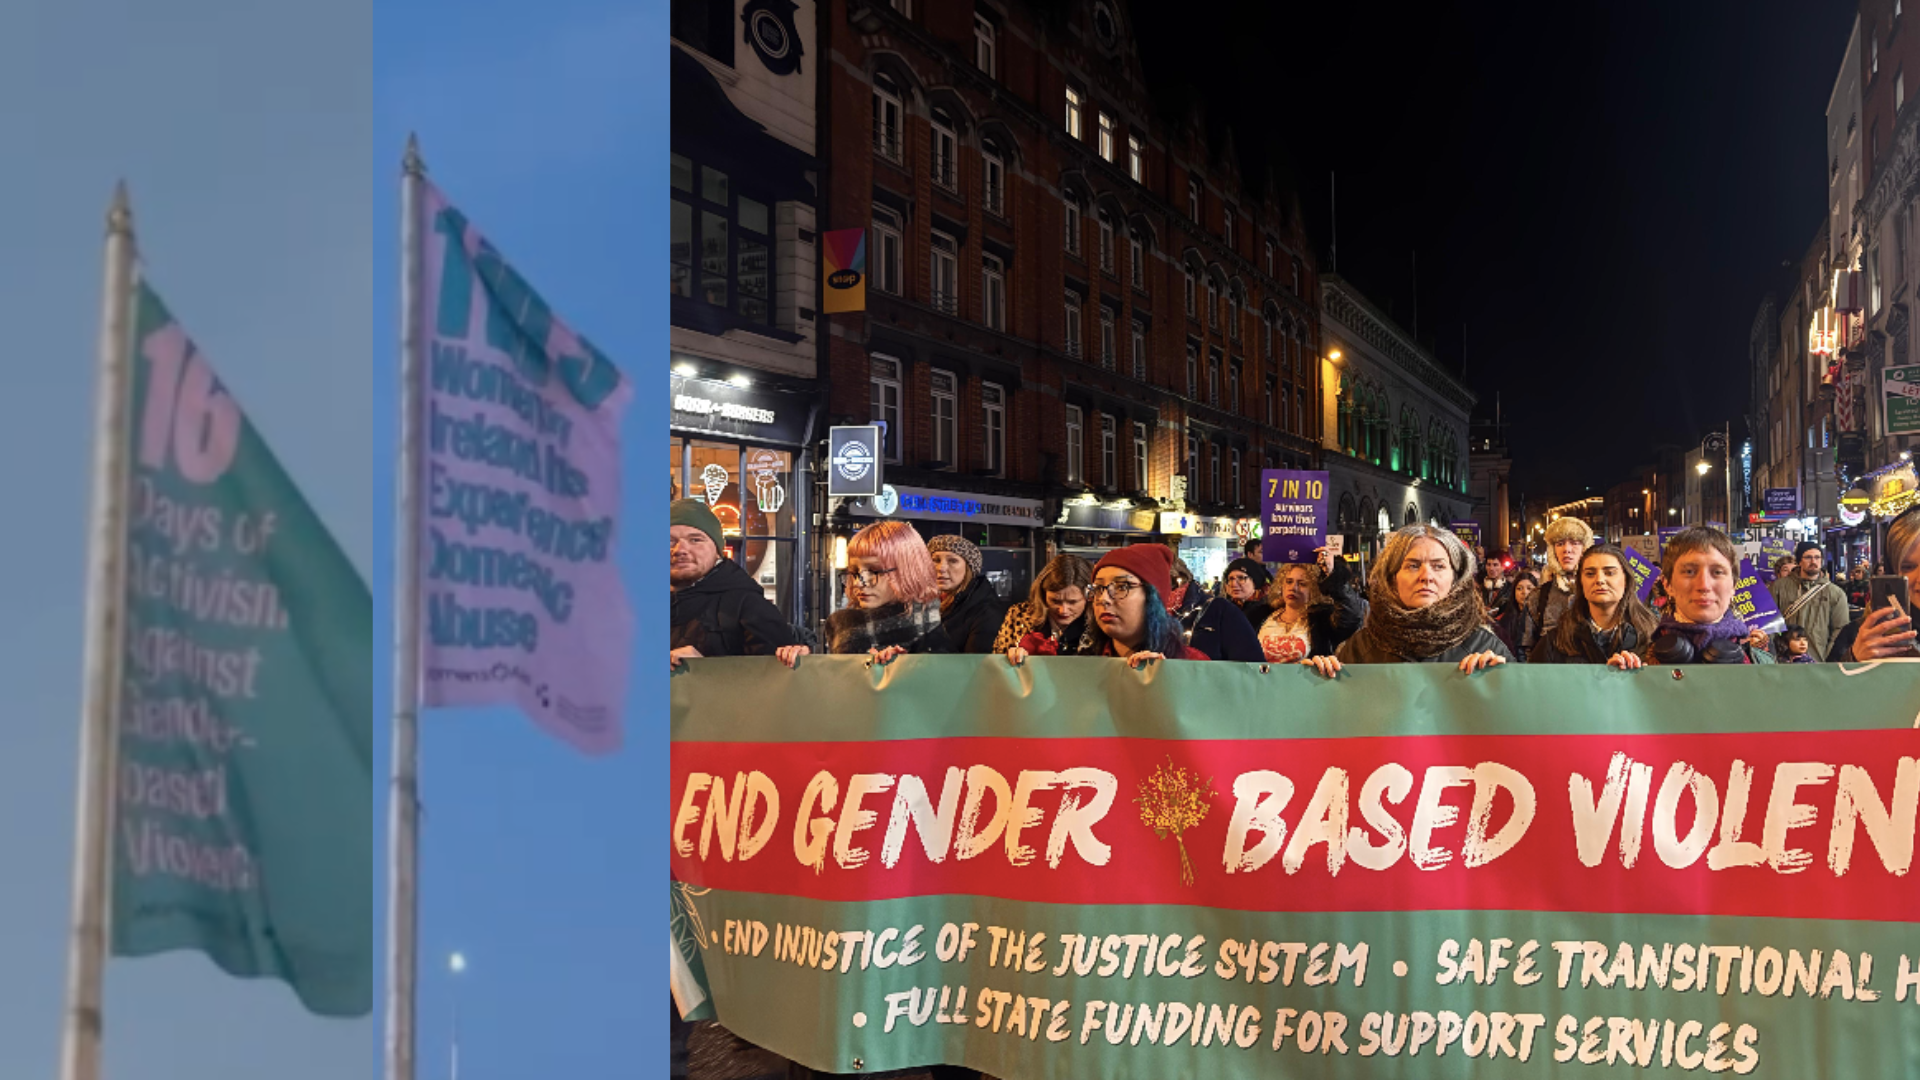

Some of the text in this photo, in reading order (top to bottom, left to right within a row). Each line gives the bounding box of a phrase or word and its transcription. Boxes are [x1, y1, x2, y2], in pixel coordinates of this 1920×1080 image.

[140, 323, 242, 484] 16
[431, 399, 542, 483] Ireland
[1268, 478, 1323, 500] 7 IN 10
[1274, 501, 1313, 513] survivors
[233, 510, 278, 555] of
[1268, 524, 1318, 537] perpetrator
[1271, 513, 1317, 525] know their
[1745, 528, 1802, 543] SILENCE
[673, 751, 1920, 877] END GENDER BASED VIOLEN
[723, 920, 769, 958] END
[775, 922, 927, 974] INJUSTICE
[936, 921, 979, 963] OF
[986, 925, 1047, 973] THE
[1053, 932, 1206, 979] JUSTICE
[1214, 939, 1370, 986] SYSTEM
[1435, 938, 1542, 987] SAFE
[1550, 940, 1883, 1003] TRANSITIONAL
[883, 984, 1760, 1077] FULL STATE FUNDING FOR SUPPORT SERVICES
